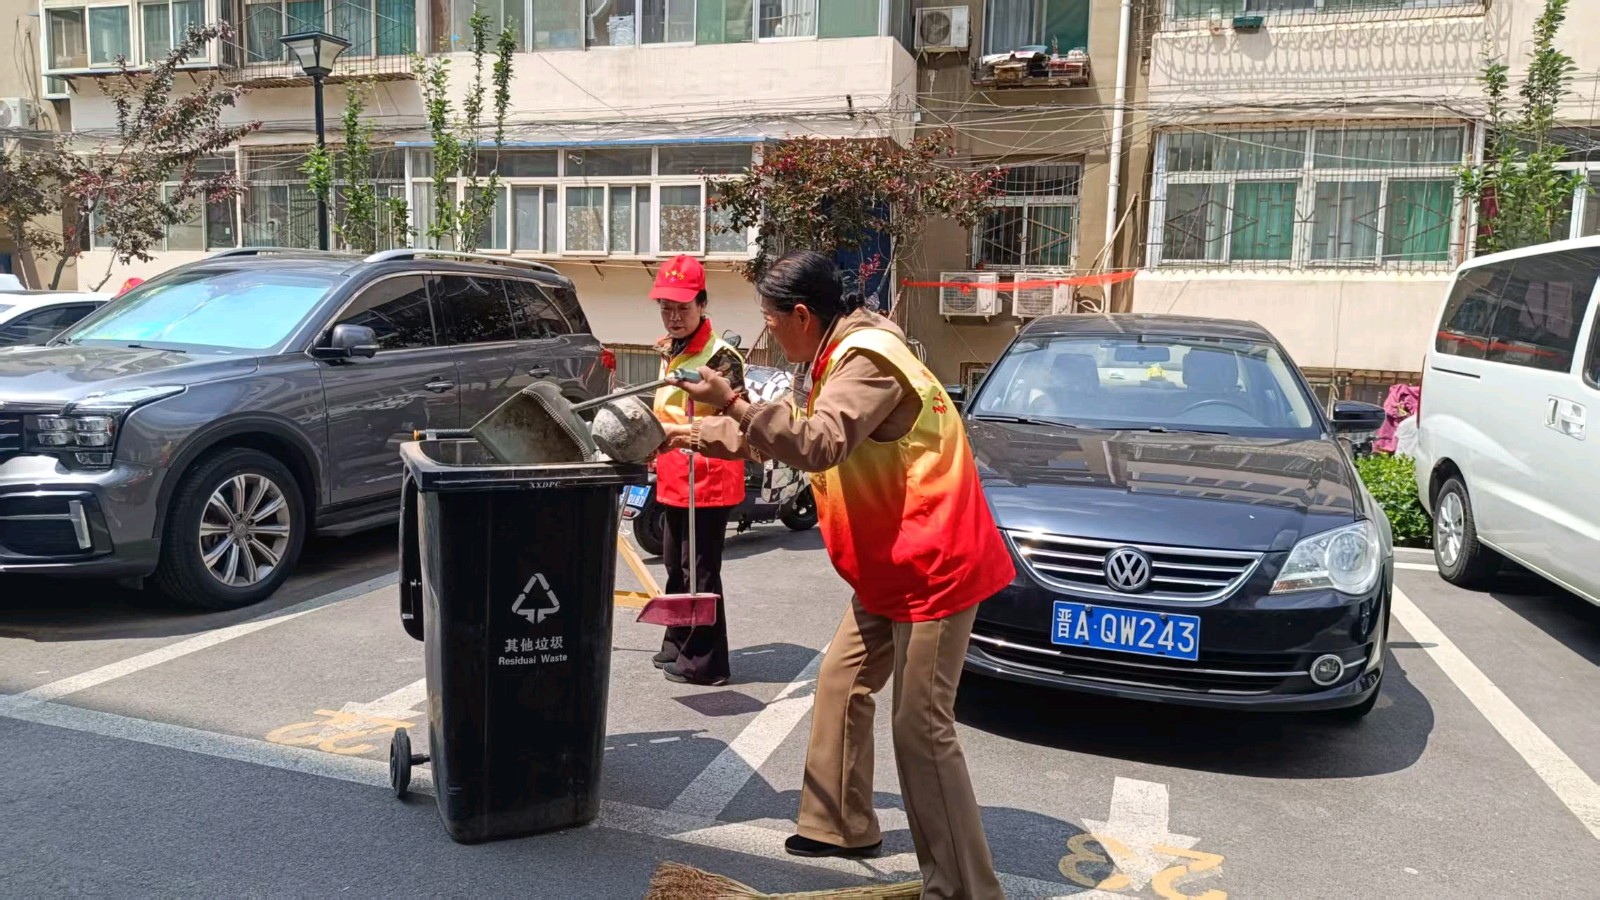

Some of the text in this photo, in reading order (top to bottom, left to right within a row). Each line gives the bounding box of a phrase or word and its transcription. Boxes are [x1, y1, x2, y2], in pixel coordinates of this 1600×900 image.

[504, 636, 564, 652] 其他垃圾
[498, 653, 568, 666] Residual Waste
